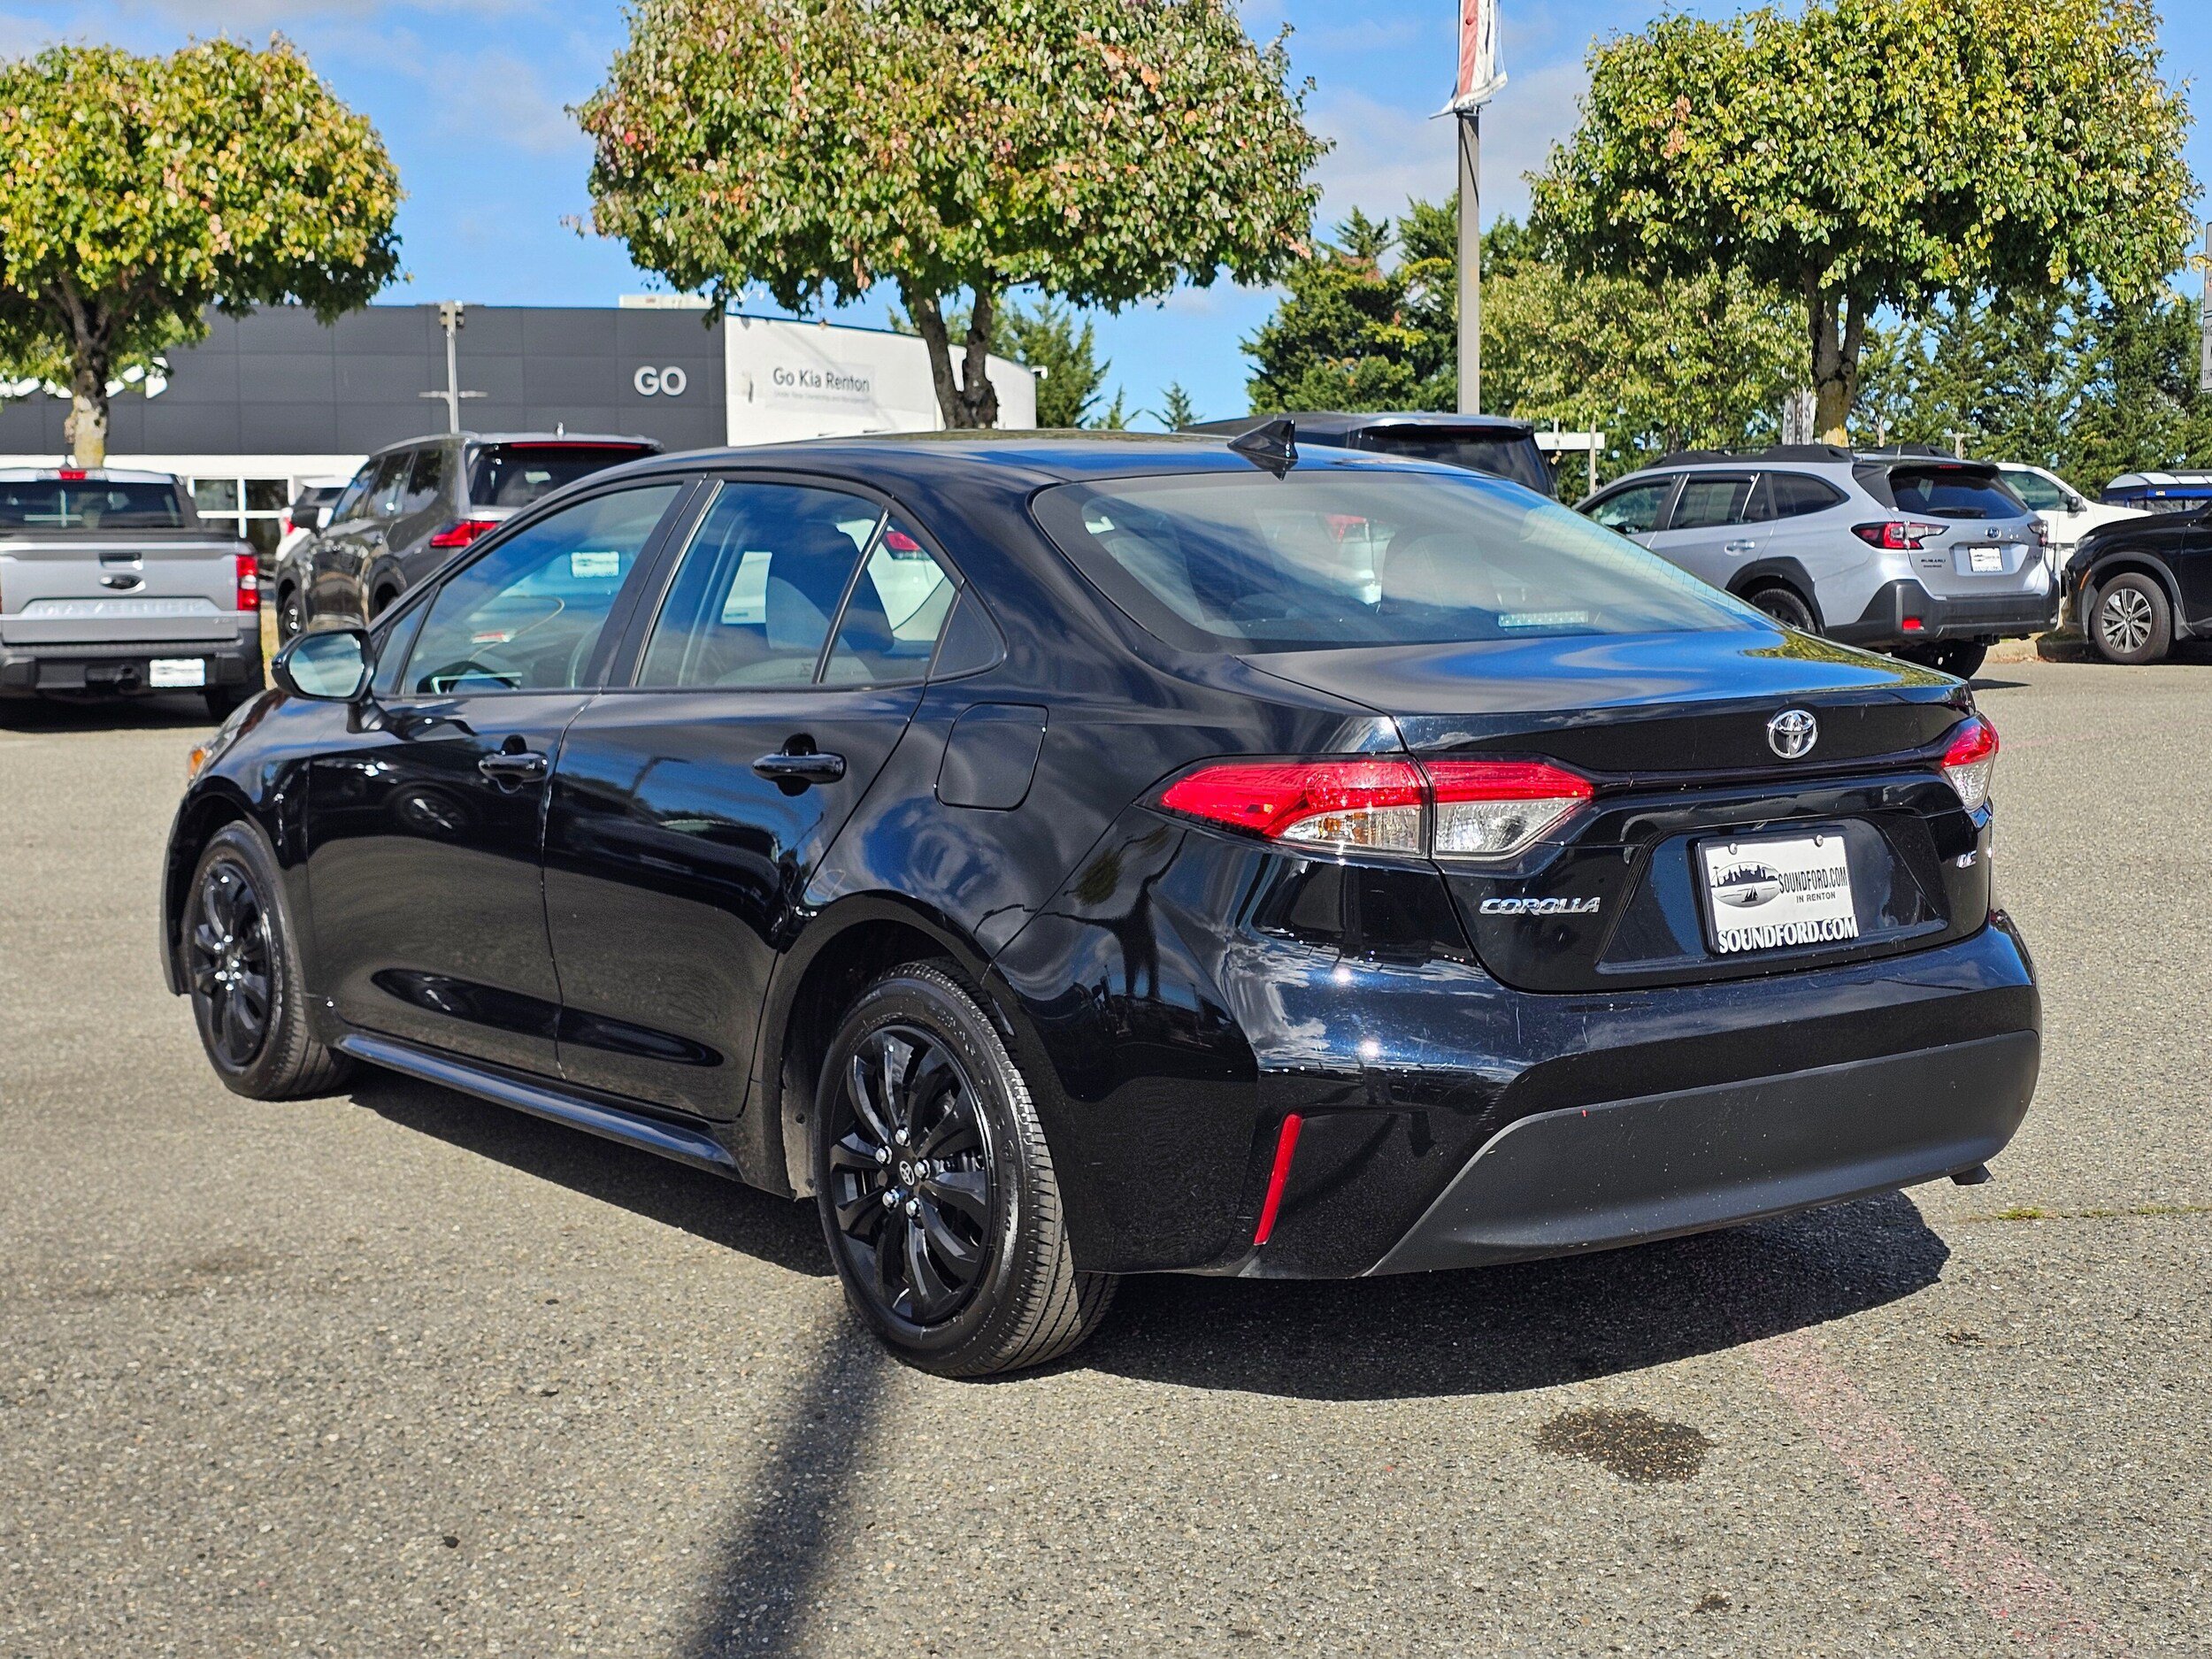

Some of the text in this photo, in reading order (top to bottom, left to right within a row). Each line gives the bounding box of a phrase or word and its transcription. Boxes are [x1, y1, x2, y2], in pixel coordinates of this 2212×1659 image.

[634, 365, 687, 396] GO
[773, 366, 870, 391] Go Kia Renton
[1778, 866, 1847, 895] SOUNDFORD.COM
[1479, 897, 1601, 915] COROLLA
[1807, 892, 1836, 902] RENTON
[1717, 915, 1859, 954] SOUNDFORD.COM
